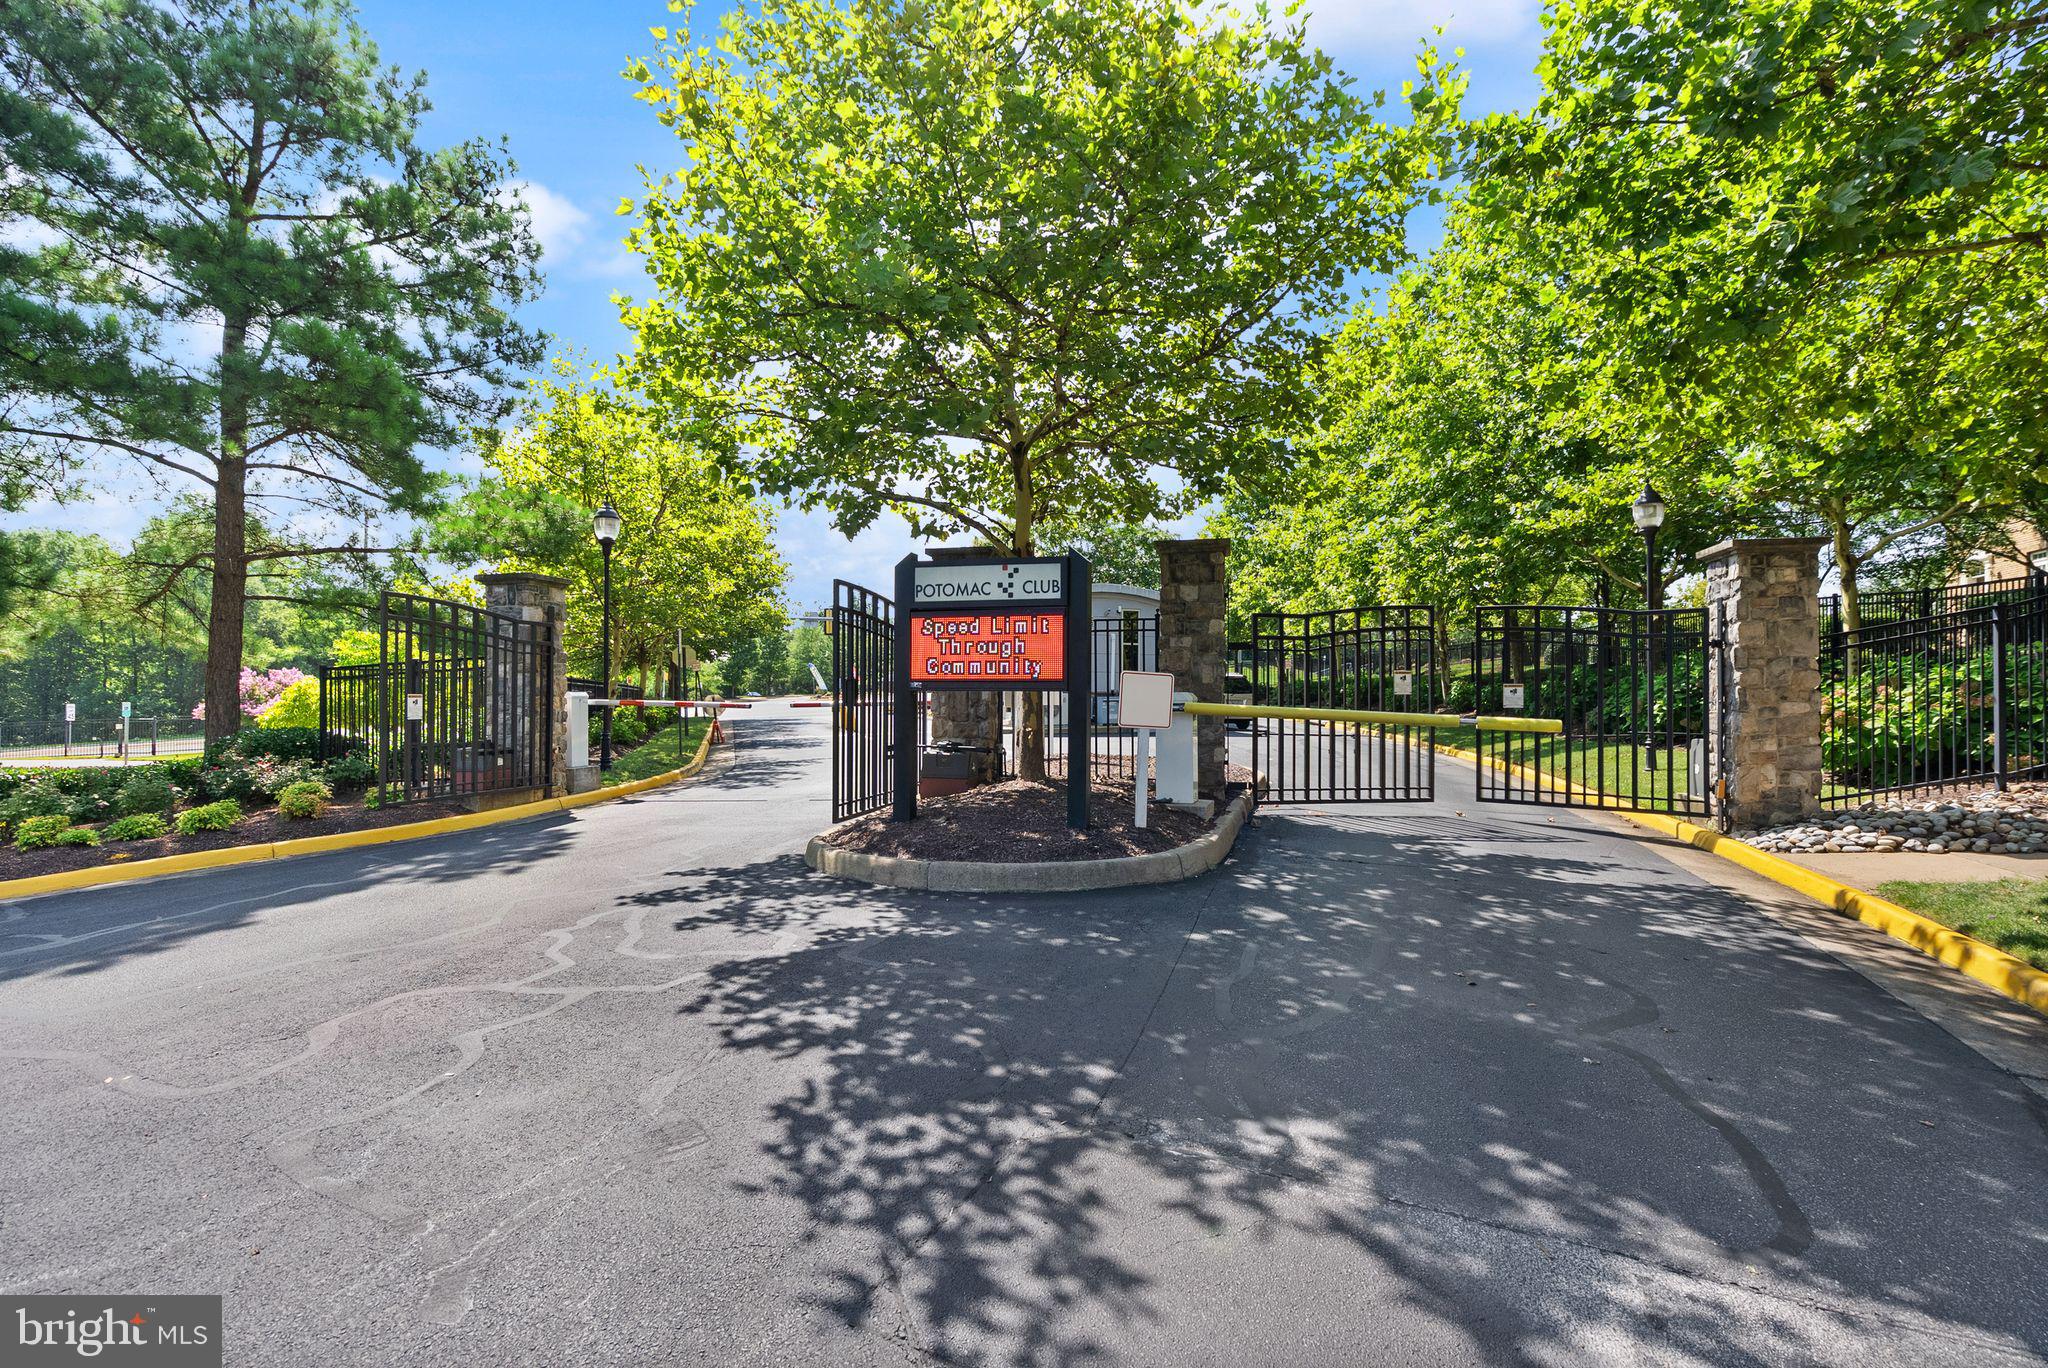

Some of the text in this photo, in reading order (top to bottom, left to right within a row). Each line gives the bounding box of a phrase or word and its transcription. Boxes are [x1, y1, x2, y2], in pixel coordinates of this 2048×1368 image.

[915, 579, 1060, 598] POTOMAC CLUB
[922, 617, 1050, 638] Speed Limit
[938, 638, 1025, 658] Through
[926, 658, 1041, 678] Community
